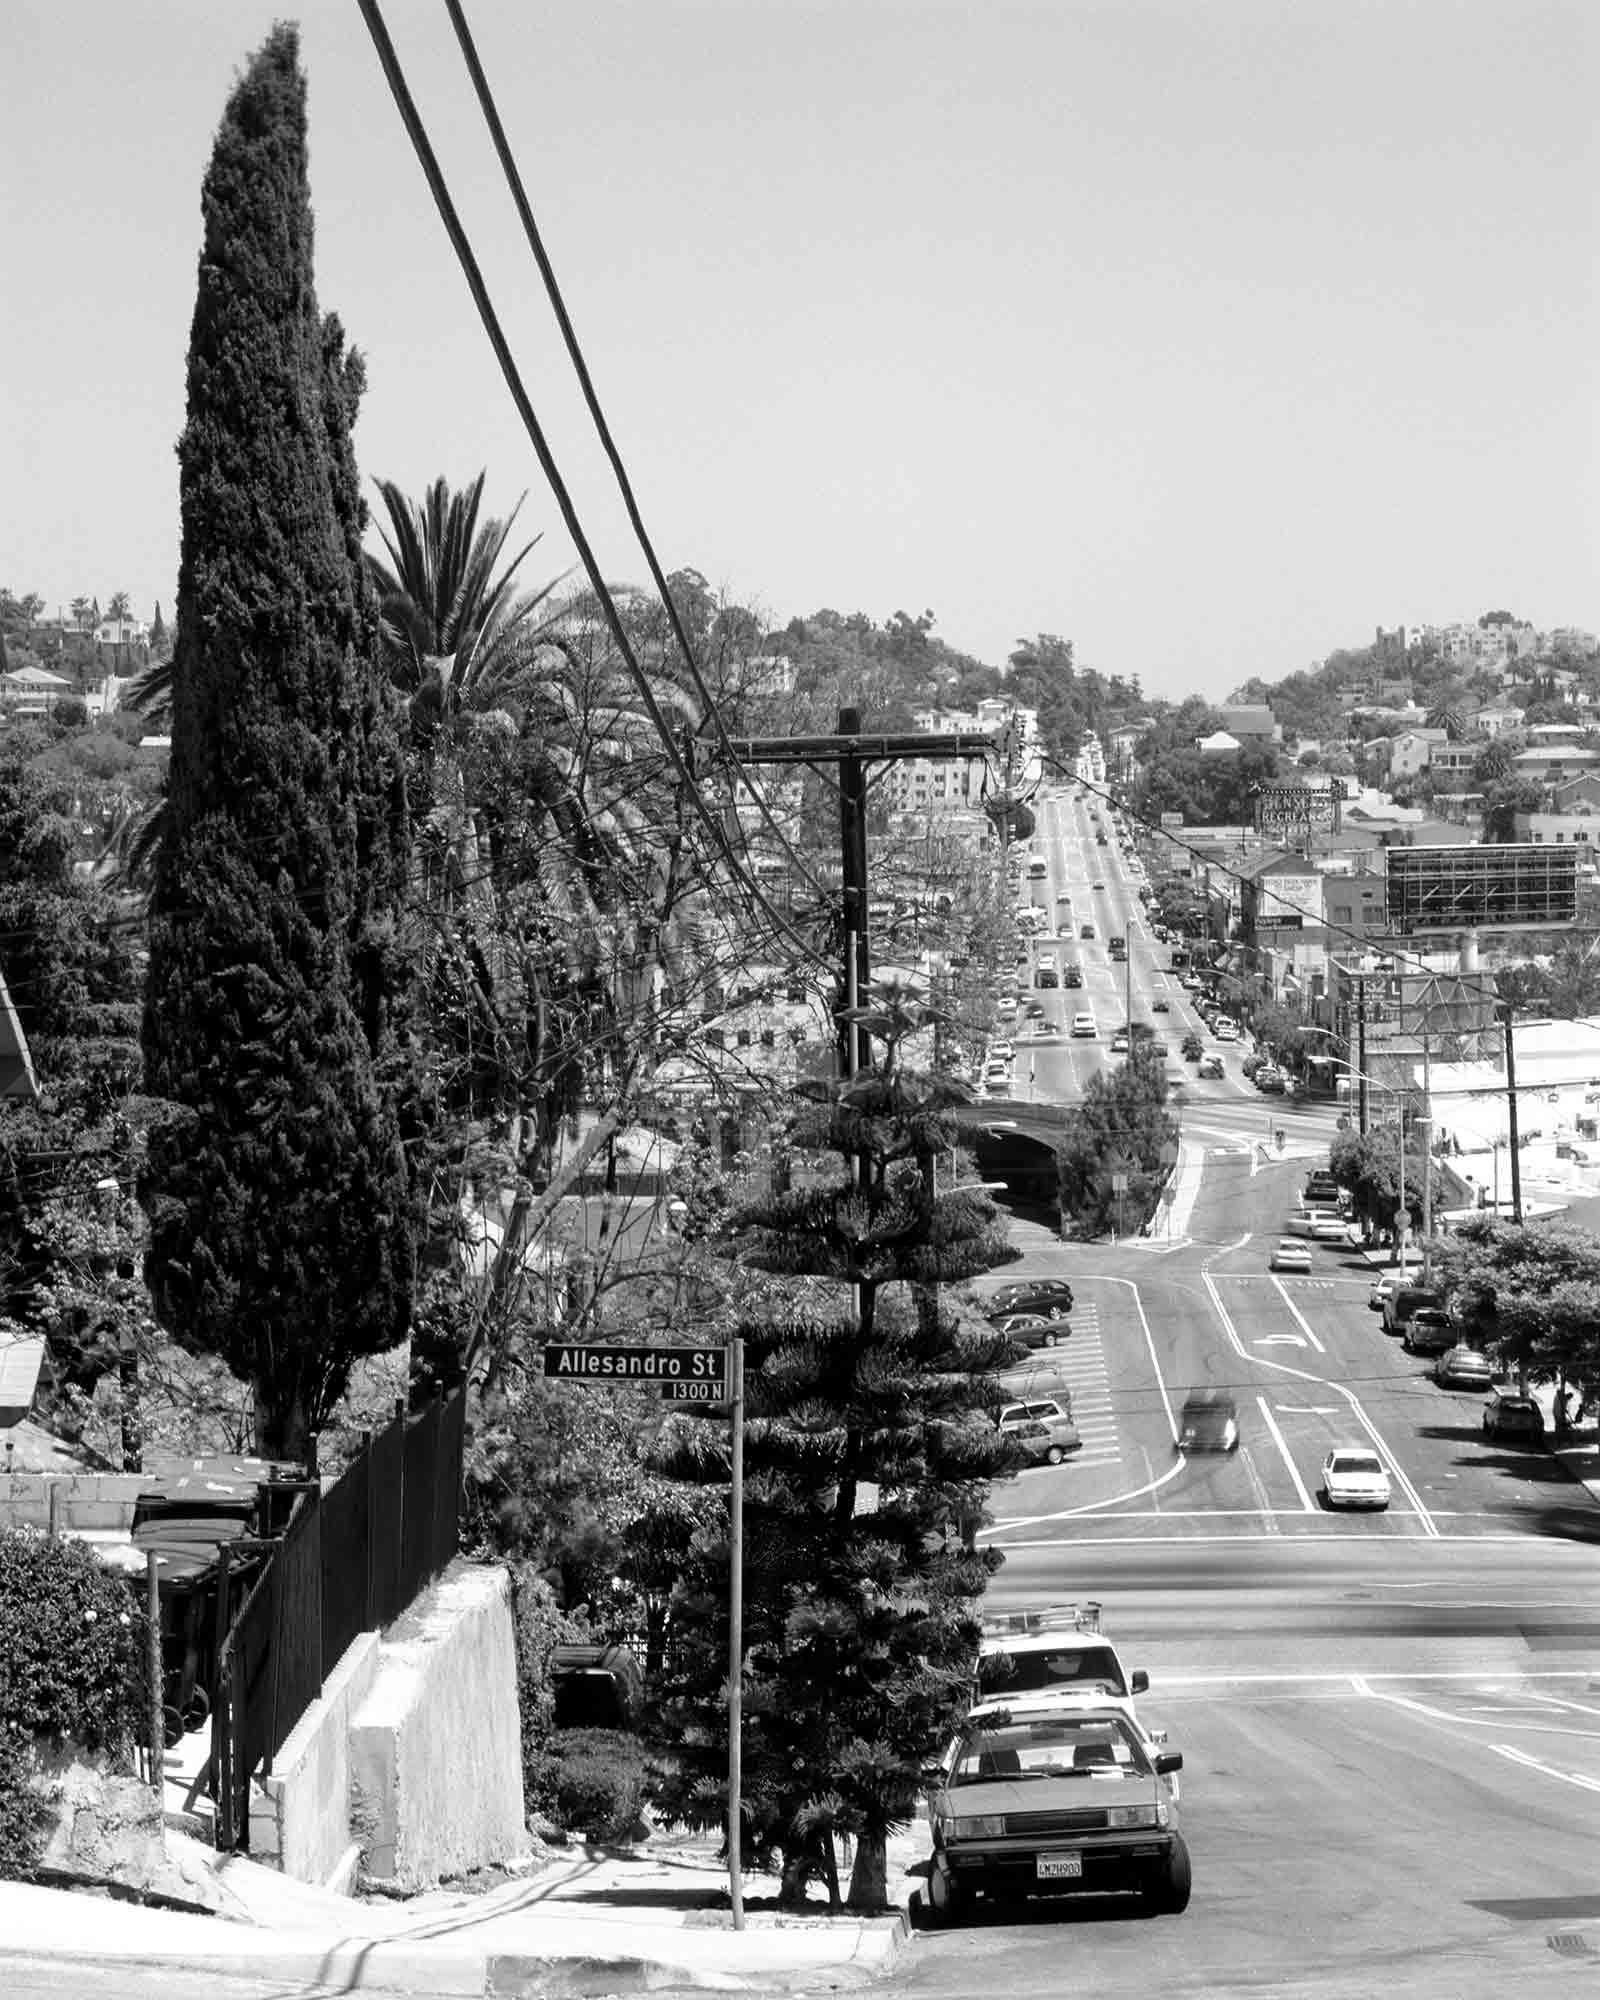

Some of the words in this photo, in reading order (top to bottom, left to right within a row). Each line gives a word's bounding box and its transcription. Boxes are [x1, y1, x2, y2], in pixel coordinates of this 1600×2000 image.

[558, 1350, 681, 1375] Allesandro
[692, 1353, 716, 1375] St
[672, 1383, 709, 1399] 1300
[712, 1384, 723, 1399] N
